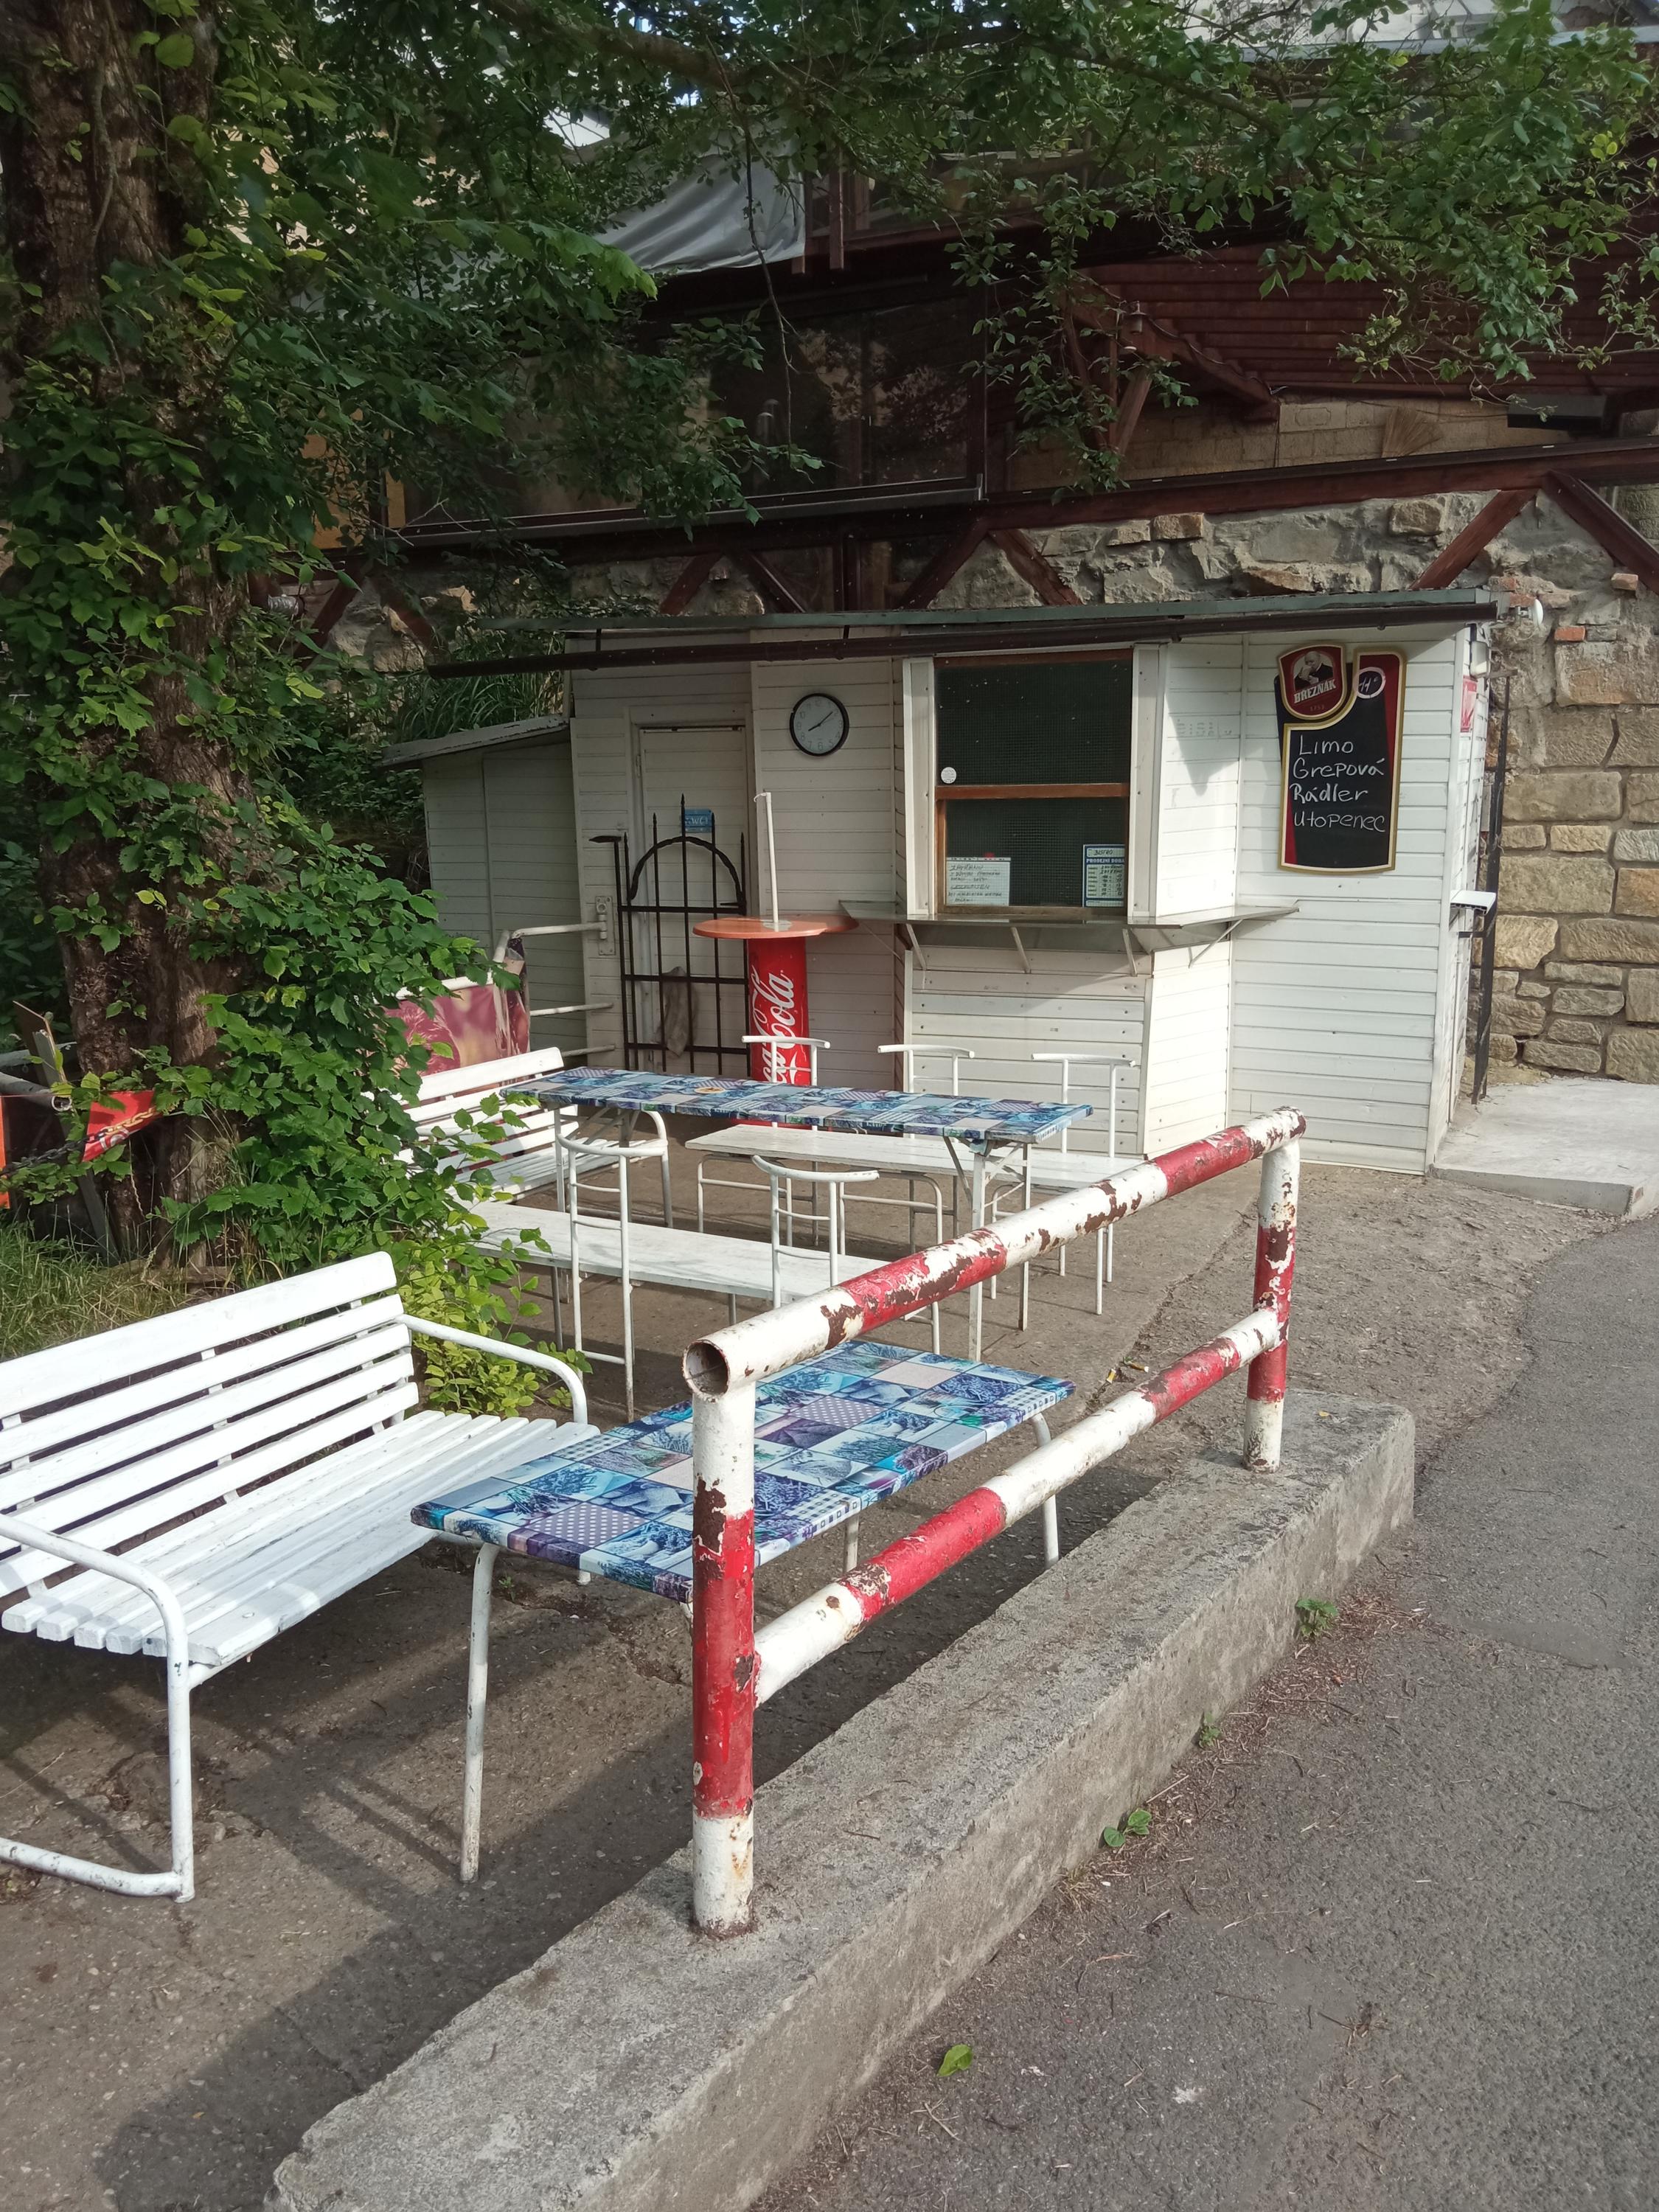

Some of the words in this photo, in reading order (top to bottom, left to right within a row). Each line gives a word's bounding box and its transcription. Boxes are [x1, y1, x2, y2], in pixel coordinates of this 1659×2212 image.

[1299, 734, 1354, 755] Limo
[1293, 757, 1385, 779] Grepová
[1289, 782, 1368, 804] Rádler
[1294, 810, 1386, 832] Utopenec
